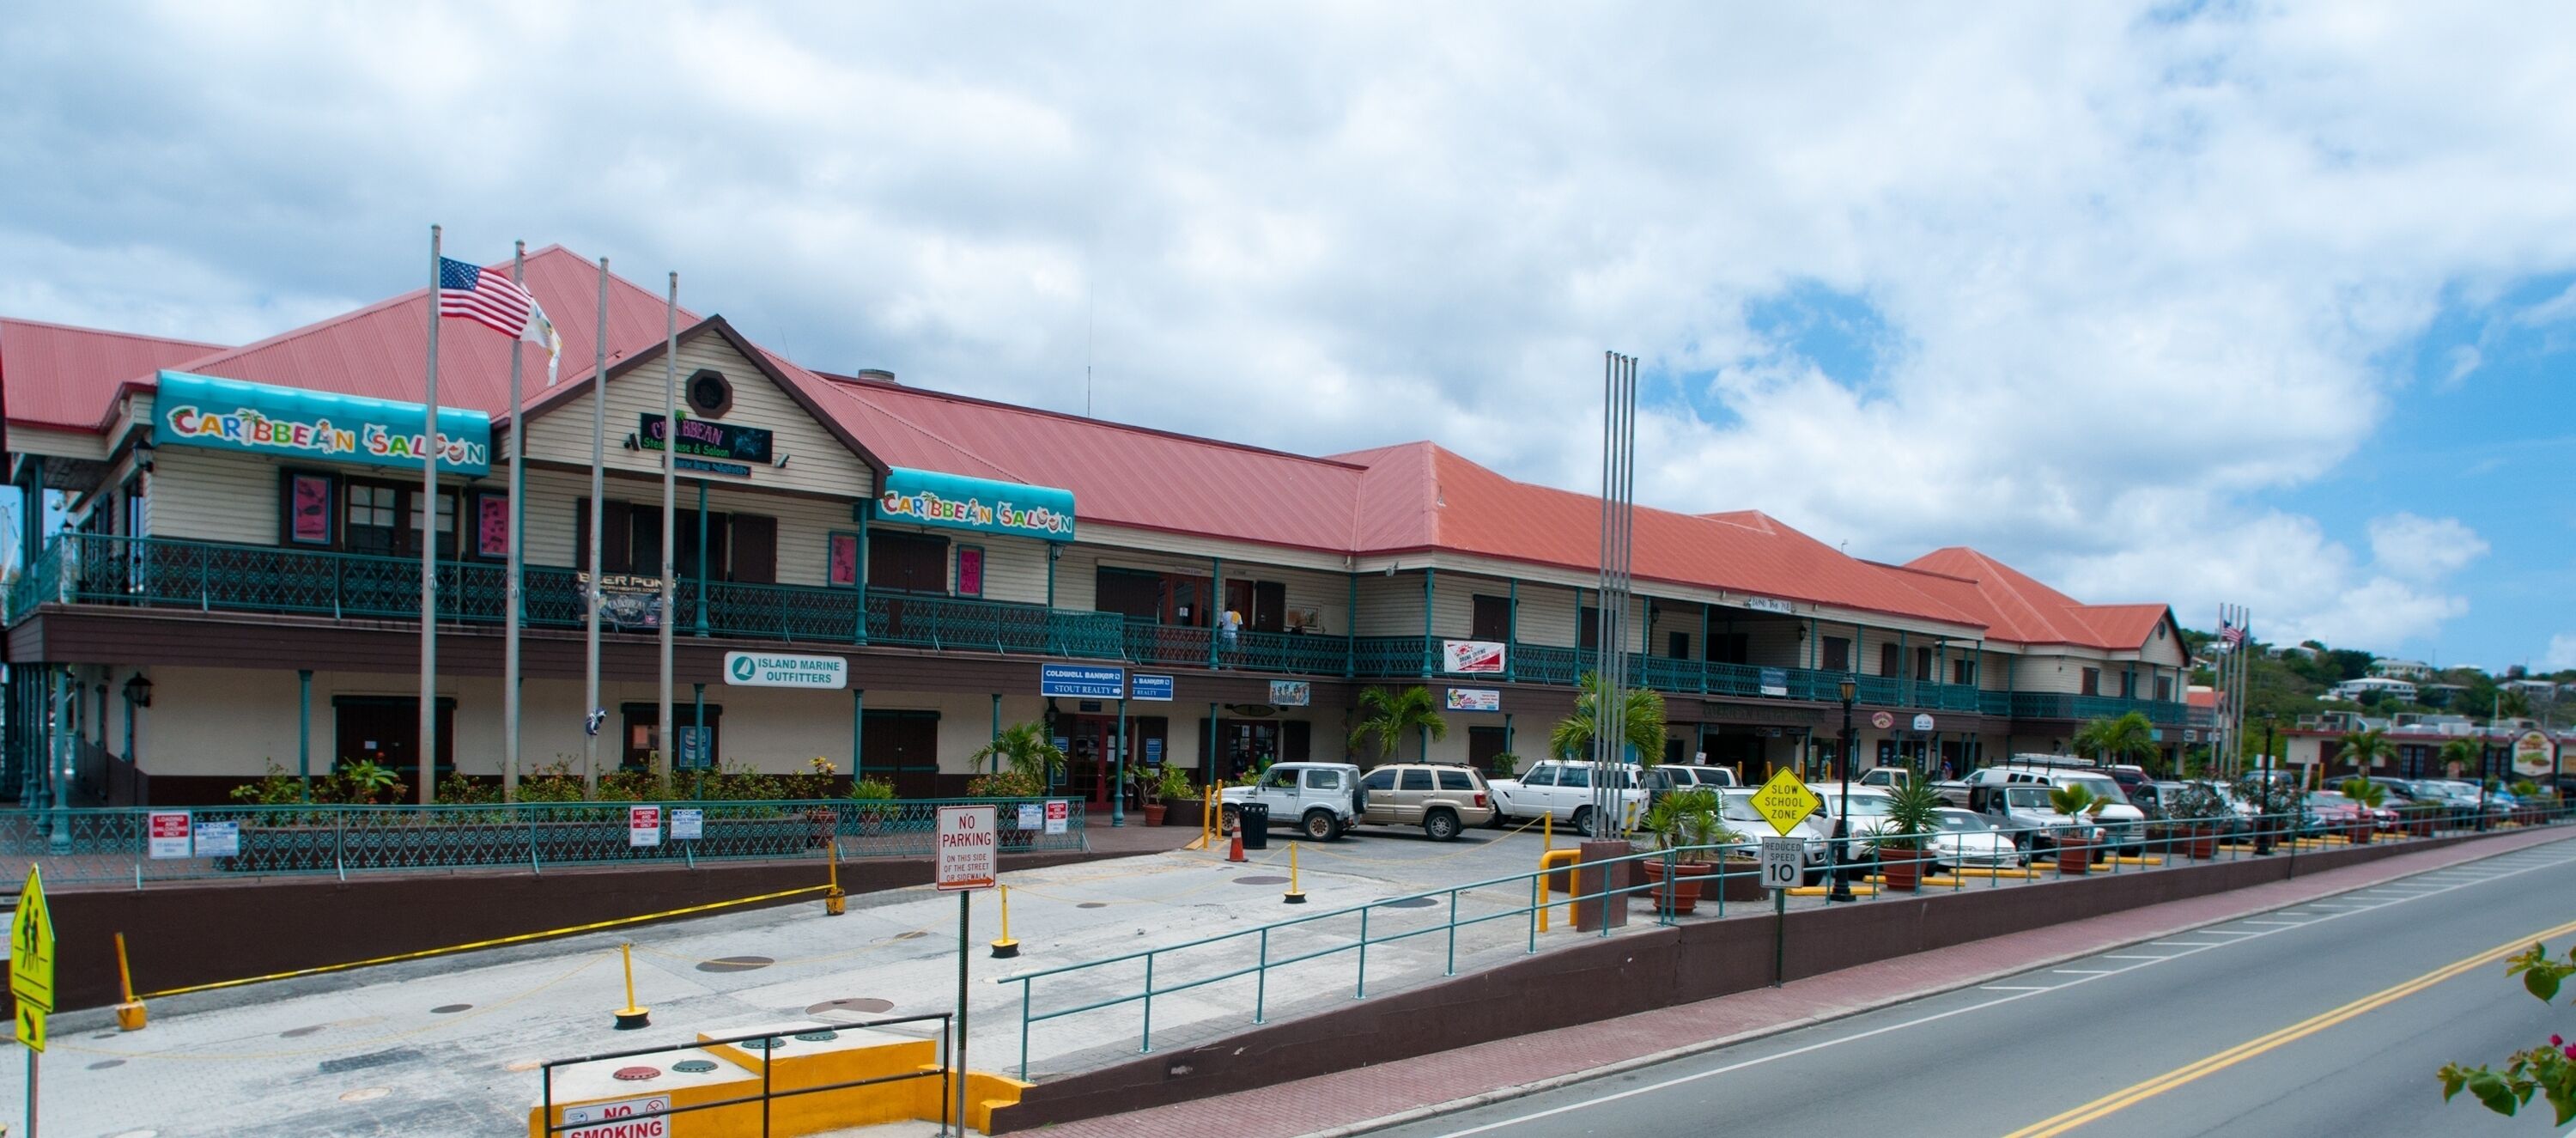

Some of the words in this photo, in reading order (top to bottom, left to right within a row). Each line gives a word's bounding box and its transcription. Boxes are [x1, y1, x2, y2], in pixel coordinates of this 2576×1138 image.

[168, 407, 354, 453] CARIBBEAN
[366, 424, 485, 465] SALOON
[644, 436, 690, 453] Steaouse
[694, 443, 700, 453] &
[702, 444, 729, 458] Saloon
[884, 492, 992, 524] CARIBBEAN
[998, 502, 1072, 532] SALOON
[578, 572, 627, 586] BER
[758, 658, 797, 669] ISLAND
[800, 660, 840, 671] MARINE
[767, 672, 831, 683] OUTFITTERS
[1046, 670, 1083, 679] COLDWELL
[1054, 685, 1079, 694] STOUT
[1083, 686, 1111, 695] REALTY
[1771, 784, 1798, 794] SLOW
[1765, 797, 1804, 807] SCHOOL
[1771, 810, 1797, 819] ZONE
[959, 815, 975, 830] NO
[943, 832, 991, 847] PARKING
[1765, 843, 1801, 851] REDUCED
[973, 853, 987, 861] SIDE
[1771, 853, 1795, 862] SPEED
[957, 873, 987, 881] SIDEWALK
[1771, 864, 1794, 882] 10
[605, 1105, 631, 1119] NO
